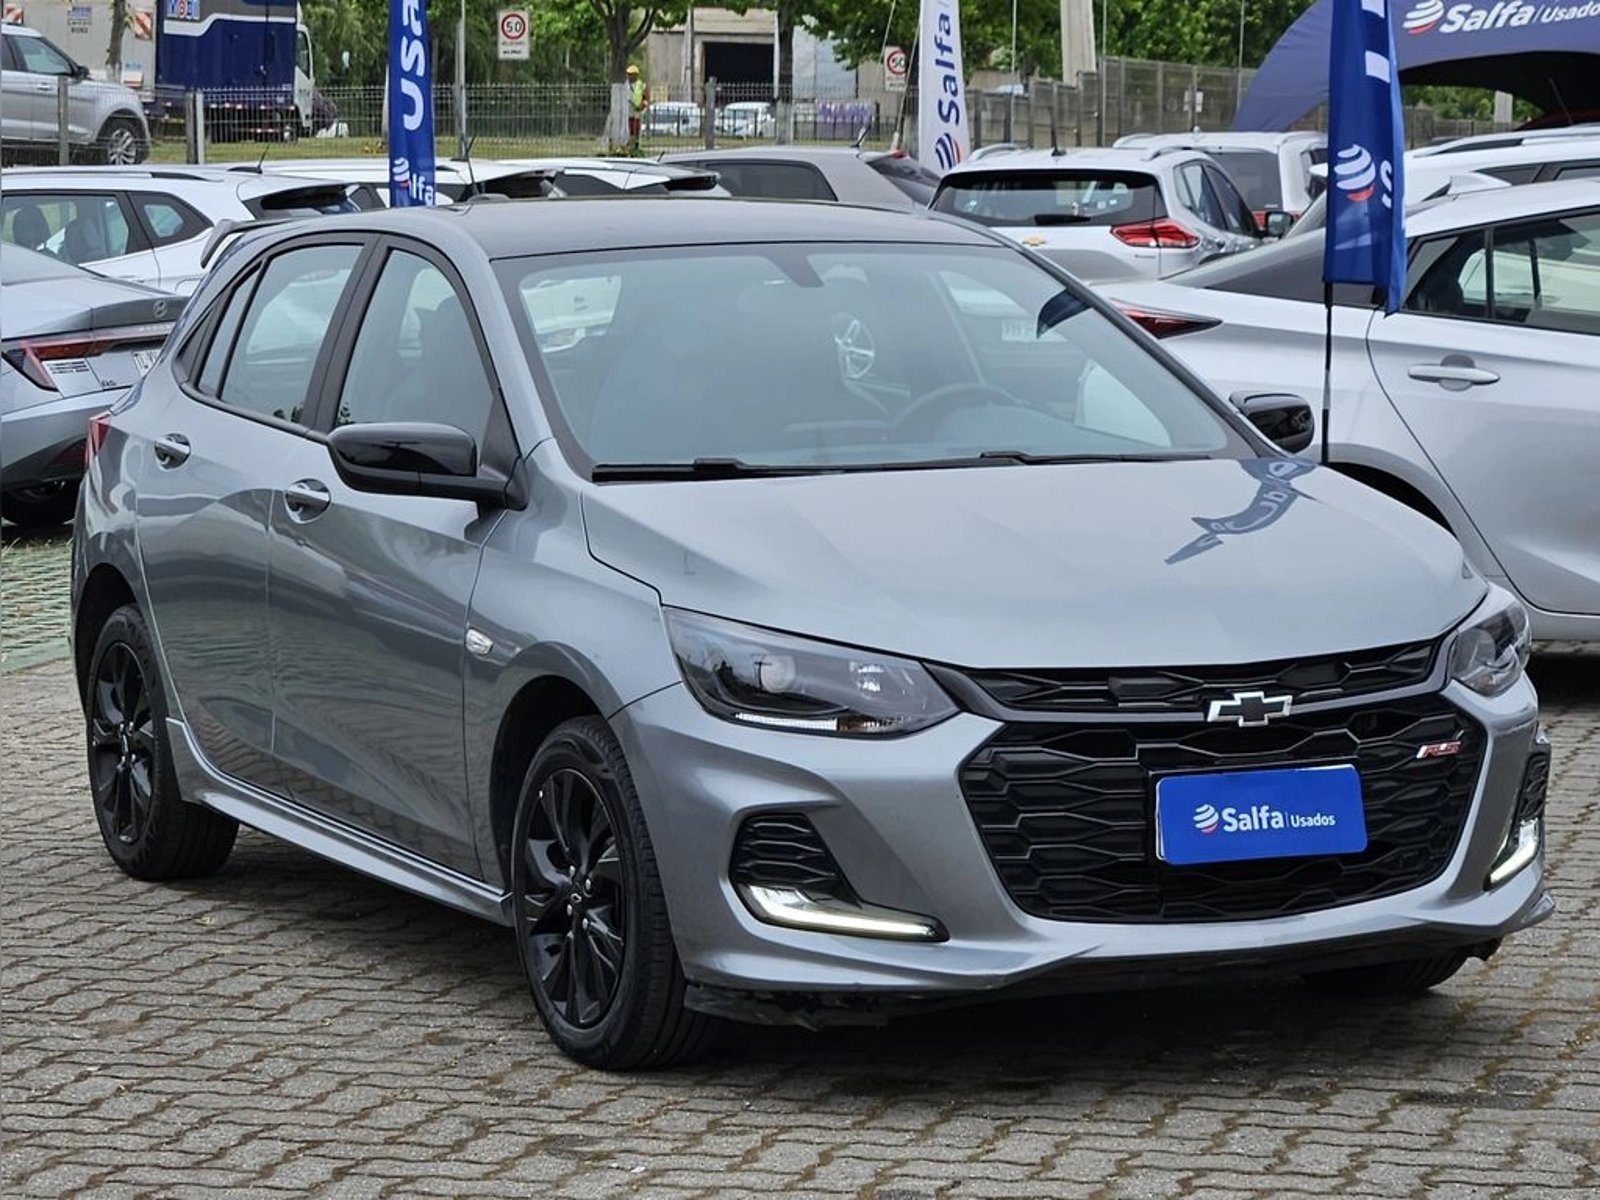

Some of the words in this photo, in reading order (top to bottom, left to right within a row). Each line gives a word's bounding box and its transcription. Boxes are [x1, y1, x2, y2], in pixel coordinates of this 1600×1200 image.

[506, 21, 522, 33] 50
[1439, 1, 1535, 33] Salfa
[934, 13, 960, 126] Salfa
[1416, 741, 1461, 759] RS
[1222, 806, 1285, 833] Salfa
[1291, 812, 1336, 828] Usados
